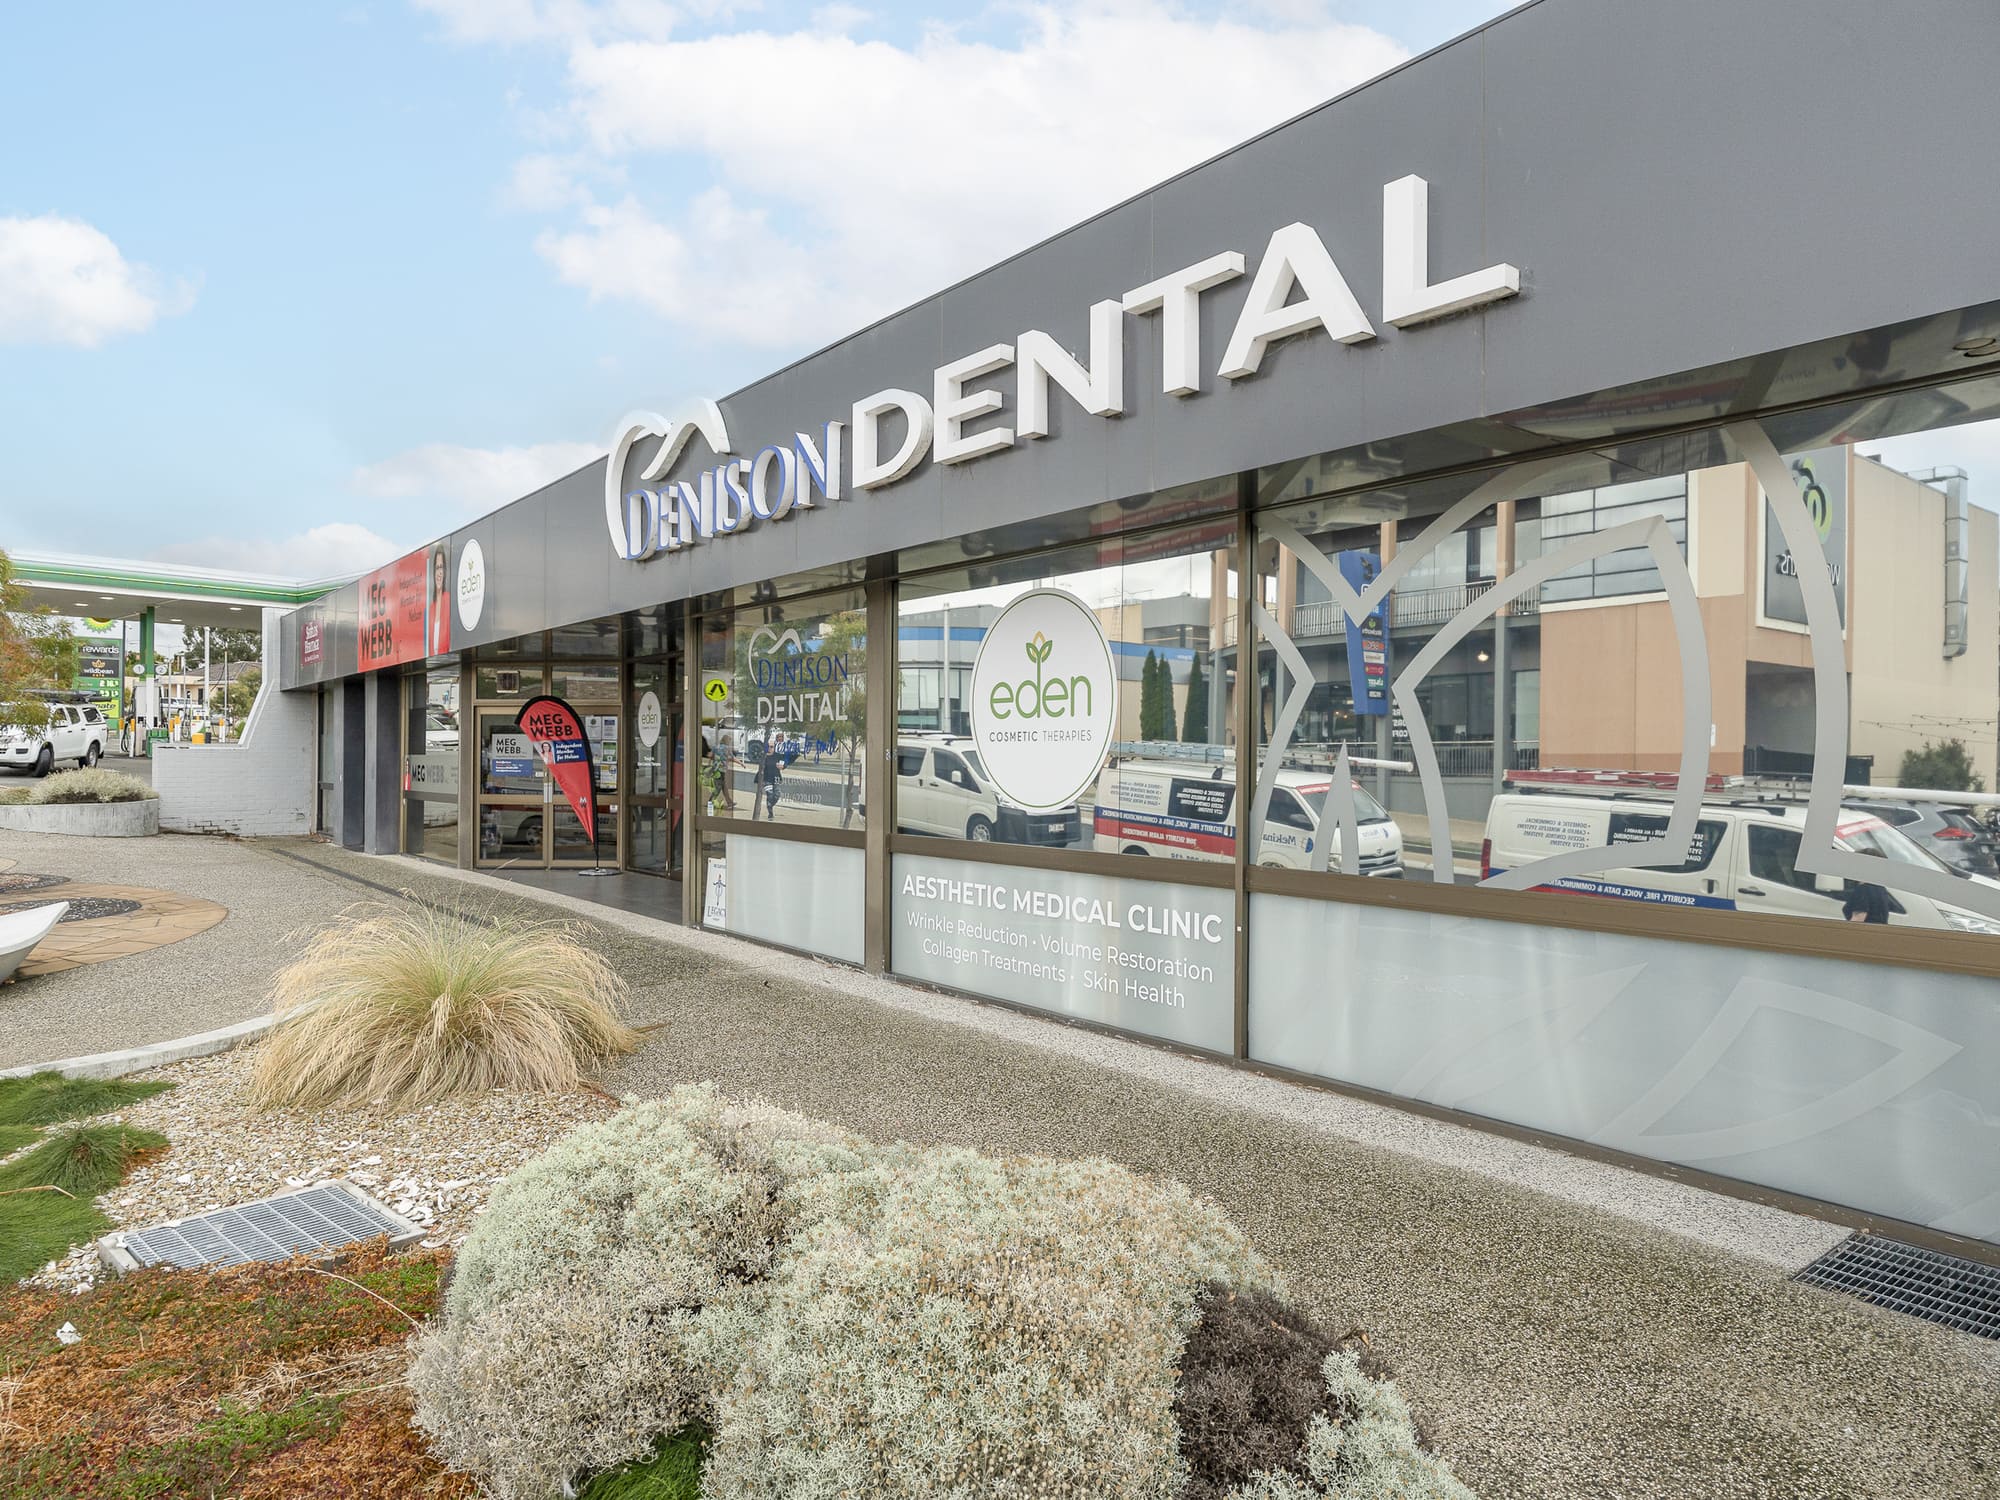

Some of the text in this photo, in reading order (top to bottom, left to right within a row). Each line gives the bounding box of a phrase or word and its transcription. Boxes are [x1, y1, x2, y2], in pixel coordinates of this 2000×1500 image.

[626, 173, 1520, 560] DENISON DENTAL
[82, 644, 119, 654] rewards
[360, 619, 393, 660] WEBB
[758, 654, 849, 689] DENISON
[990, 655, 1092, 719] eden
[530, 713, 563, 727] MEG
[641, 711, 657, 724] eden
[757, 692, 849, 724] DENTAL
[496, 738, 517, 746] MEG
[530, 725, 573, 738] WEBB
[989, 729, 1092, 742] COSMETIC THERAPIES
[496, 746, 521, 754] WEBB
[411, 764, 426, 782] MEG
[902, 874, 1222, 943] AESTHETIC MEDICAL CLINIC
[907, 911, 1214, 983] Wrinkle Reduction Volume Restoration
[923, 938, 1185, 1009] Collagen Treatments Skin Health
